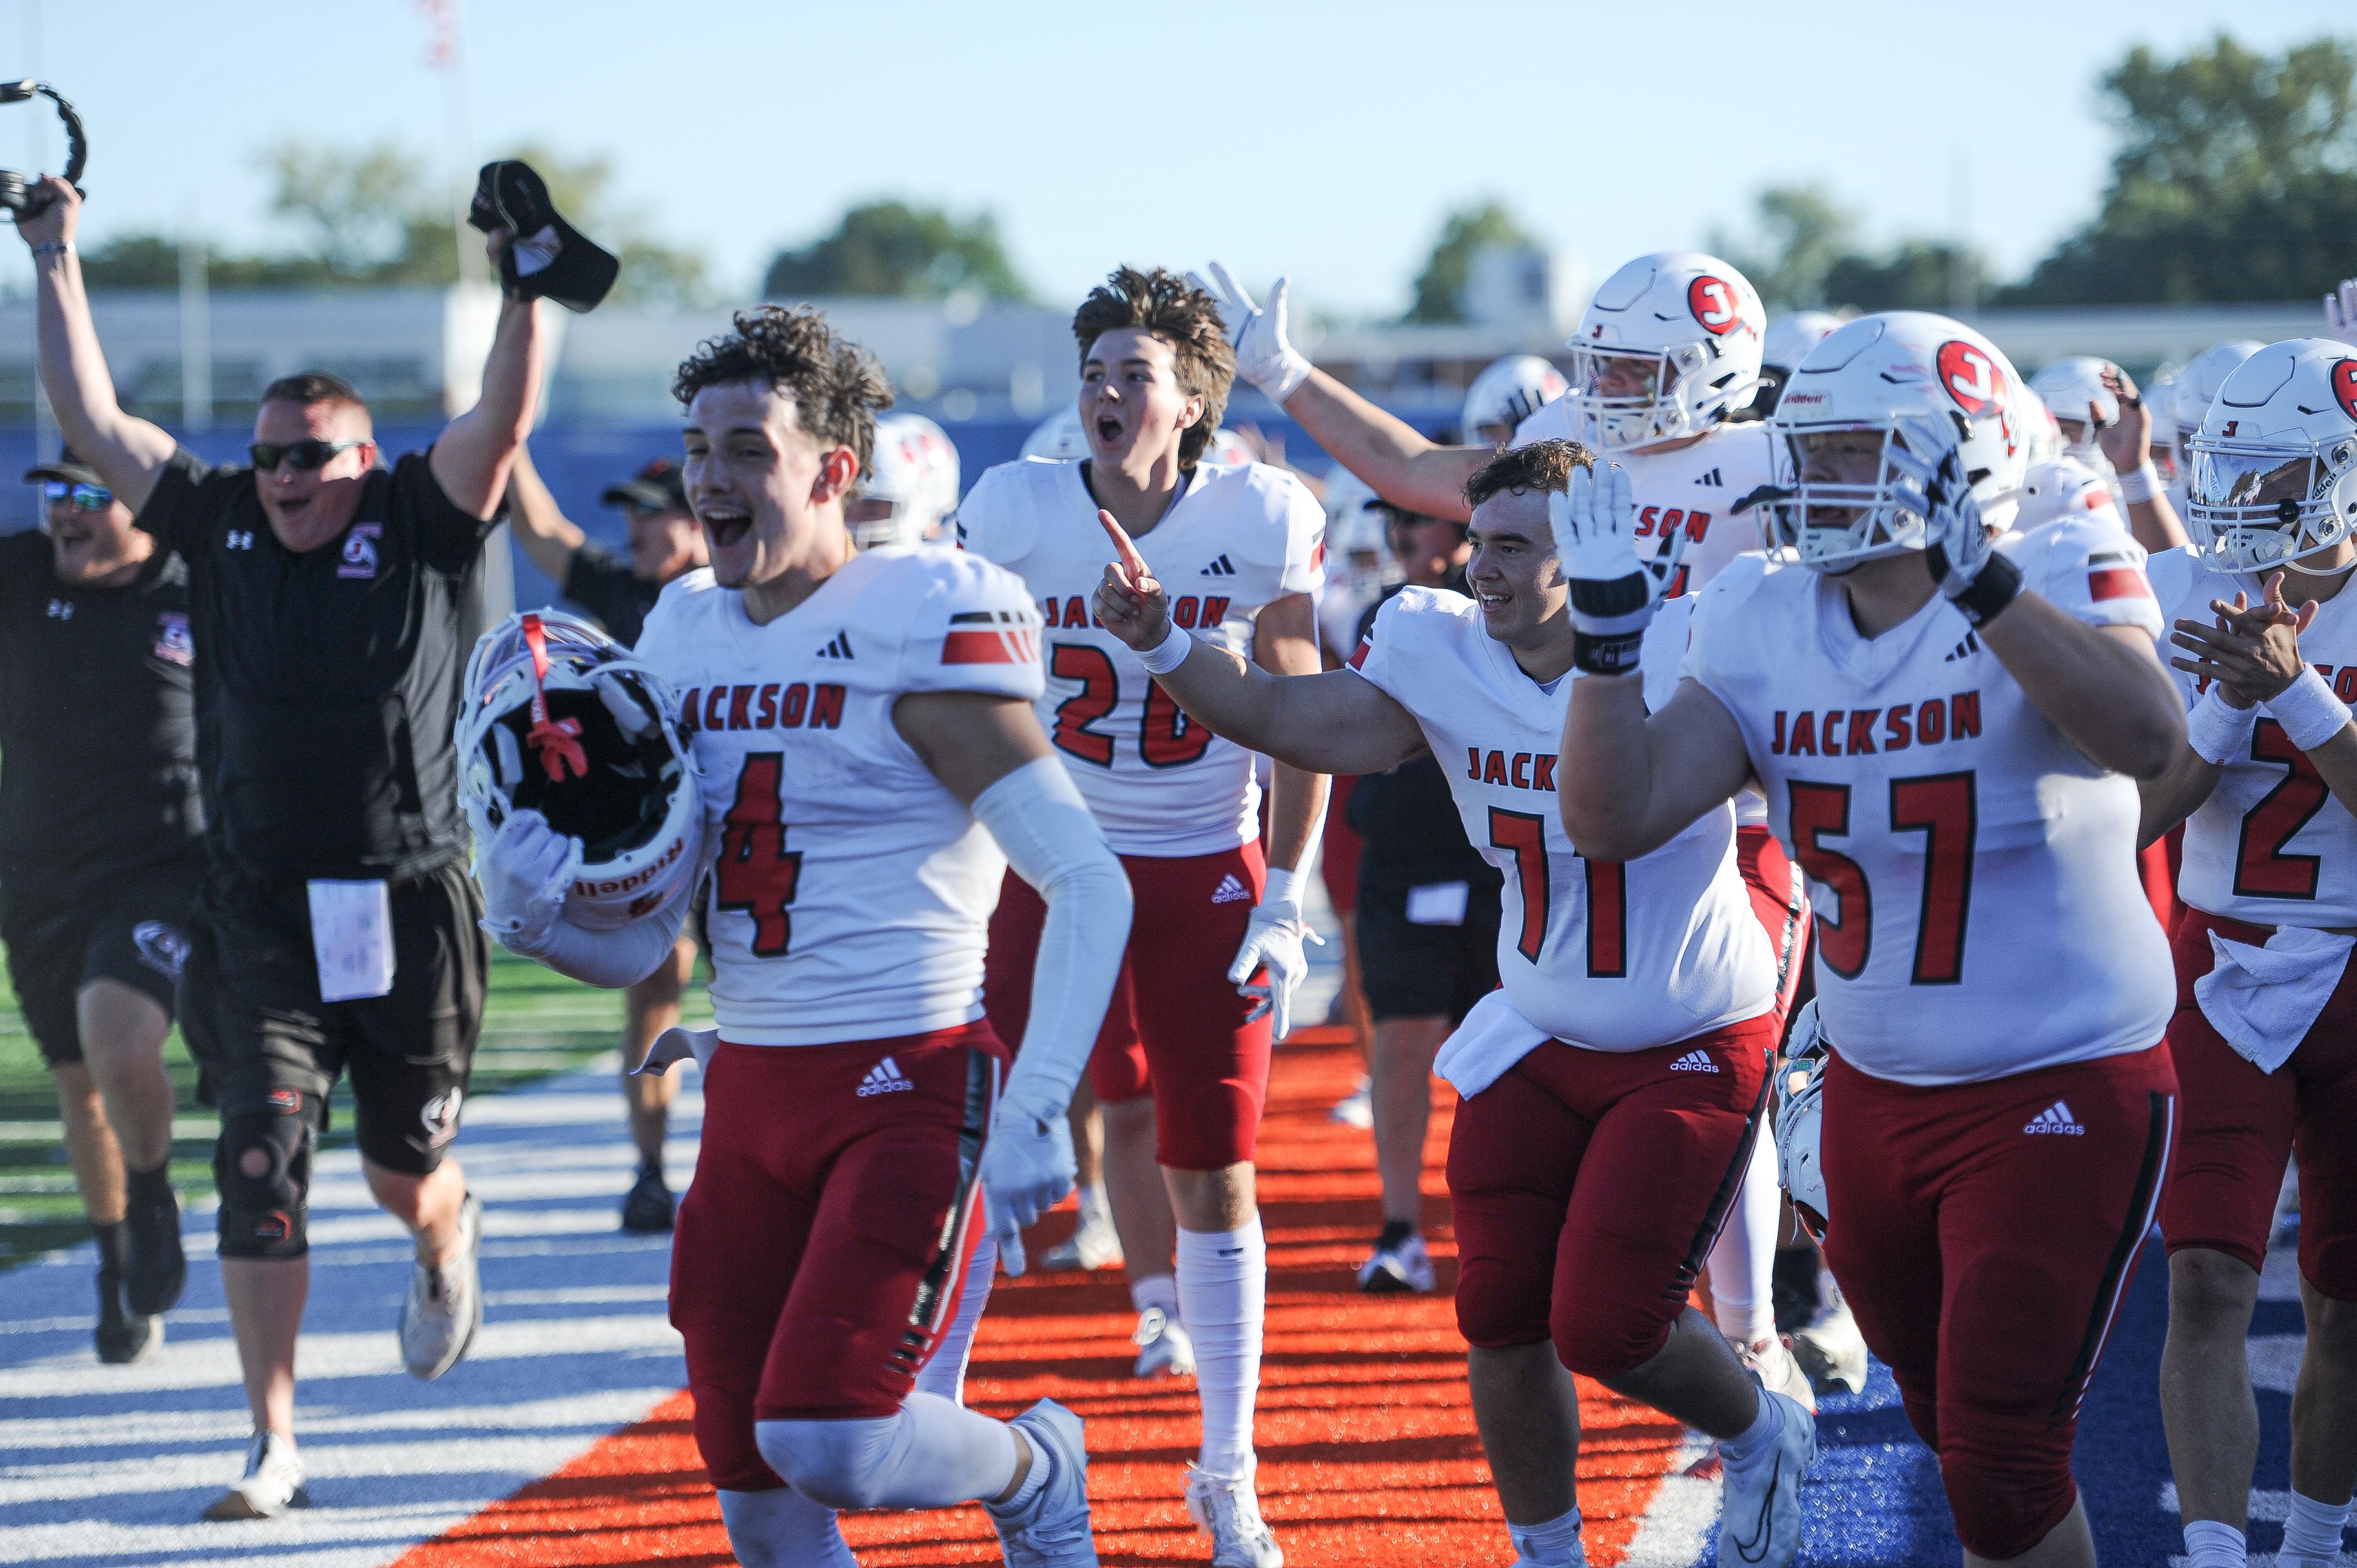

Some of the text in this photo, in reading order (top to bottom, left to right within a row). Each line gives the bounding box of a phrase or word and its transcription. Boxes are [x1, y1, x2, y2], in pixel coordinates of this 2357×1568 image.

[1703, 282, 1734, 326] J
[1951, 351, 1994, 403] J
[2221, 420, 2240, 438] J
[1631, 503, 1712, 543] SON
[1046, 595, 1231, 628] JAON
[675, 682, 846, 732] ACKSON
[1771, 689, 1983, 757] JACKSON
[2232, 716, 2331, 901] 2
[716, 751, 803, 958] 4
[1211, 890, 1252, 904] adidas
[1787, 769, 1977, 987] 57
[856, 1078, 914, 1097] adidas
[1670, 1060, 1719, 1073] adidas
[2024, 1121, 2085, 1136] adidas
